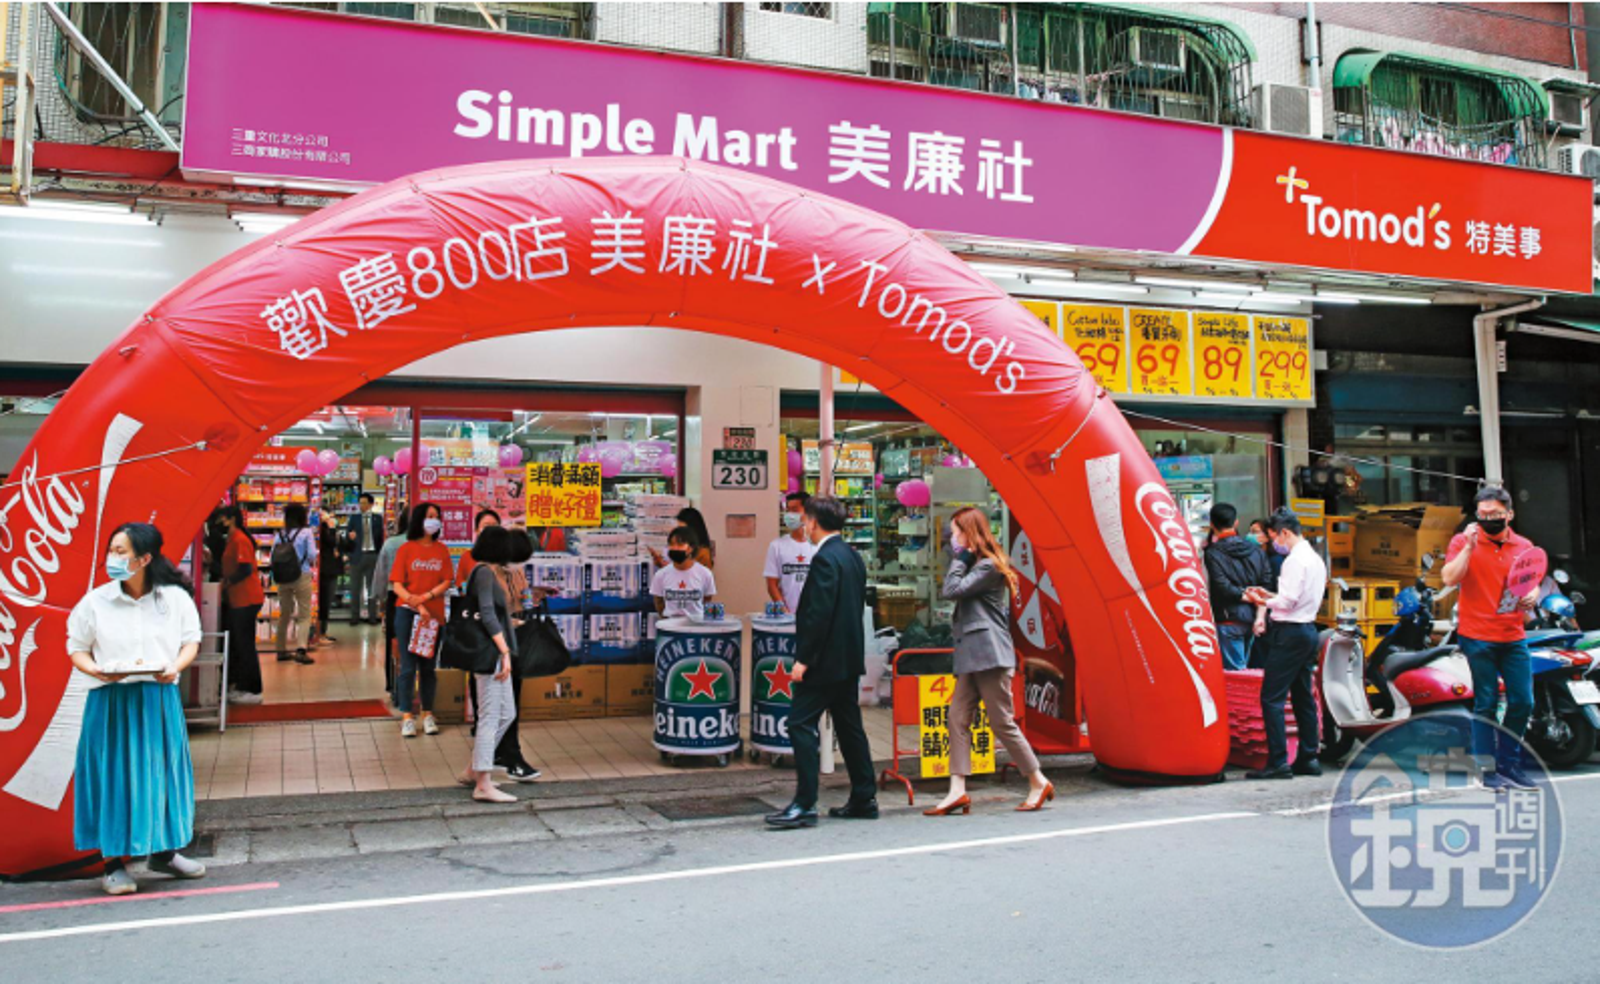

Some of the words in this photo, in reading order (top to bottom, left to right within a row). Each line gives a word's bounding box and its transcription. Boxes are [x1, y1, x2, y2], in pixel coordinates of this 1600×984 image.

[453, 89, 655, 158] Simple
[672, 112, 799, 171] Mart
[827, 120, 1035, 204] 美廉社
[1465, 219, 1542, 260] 特美事
[589, 209, 779, 286] 美廉社
[857, 259, 1026, 395] Tomod's
[1136, 343, 1181, 377] 69
[1202, 344, 1243, 382] 89
[1258, 349, 1308, 381] 299
[720, 466, 761, 487] 230
[529, 489, 600, 521] 贈好禮
